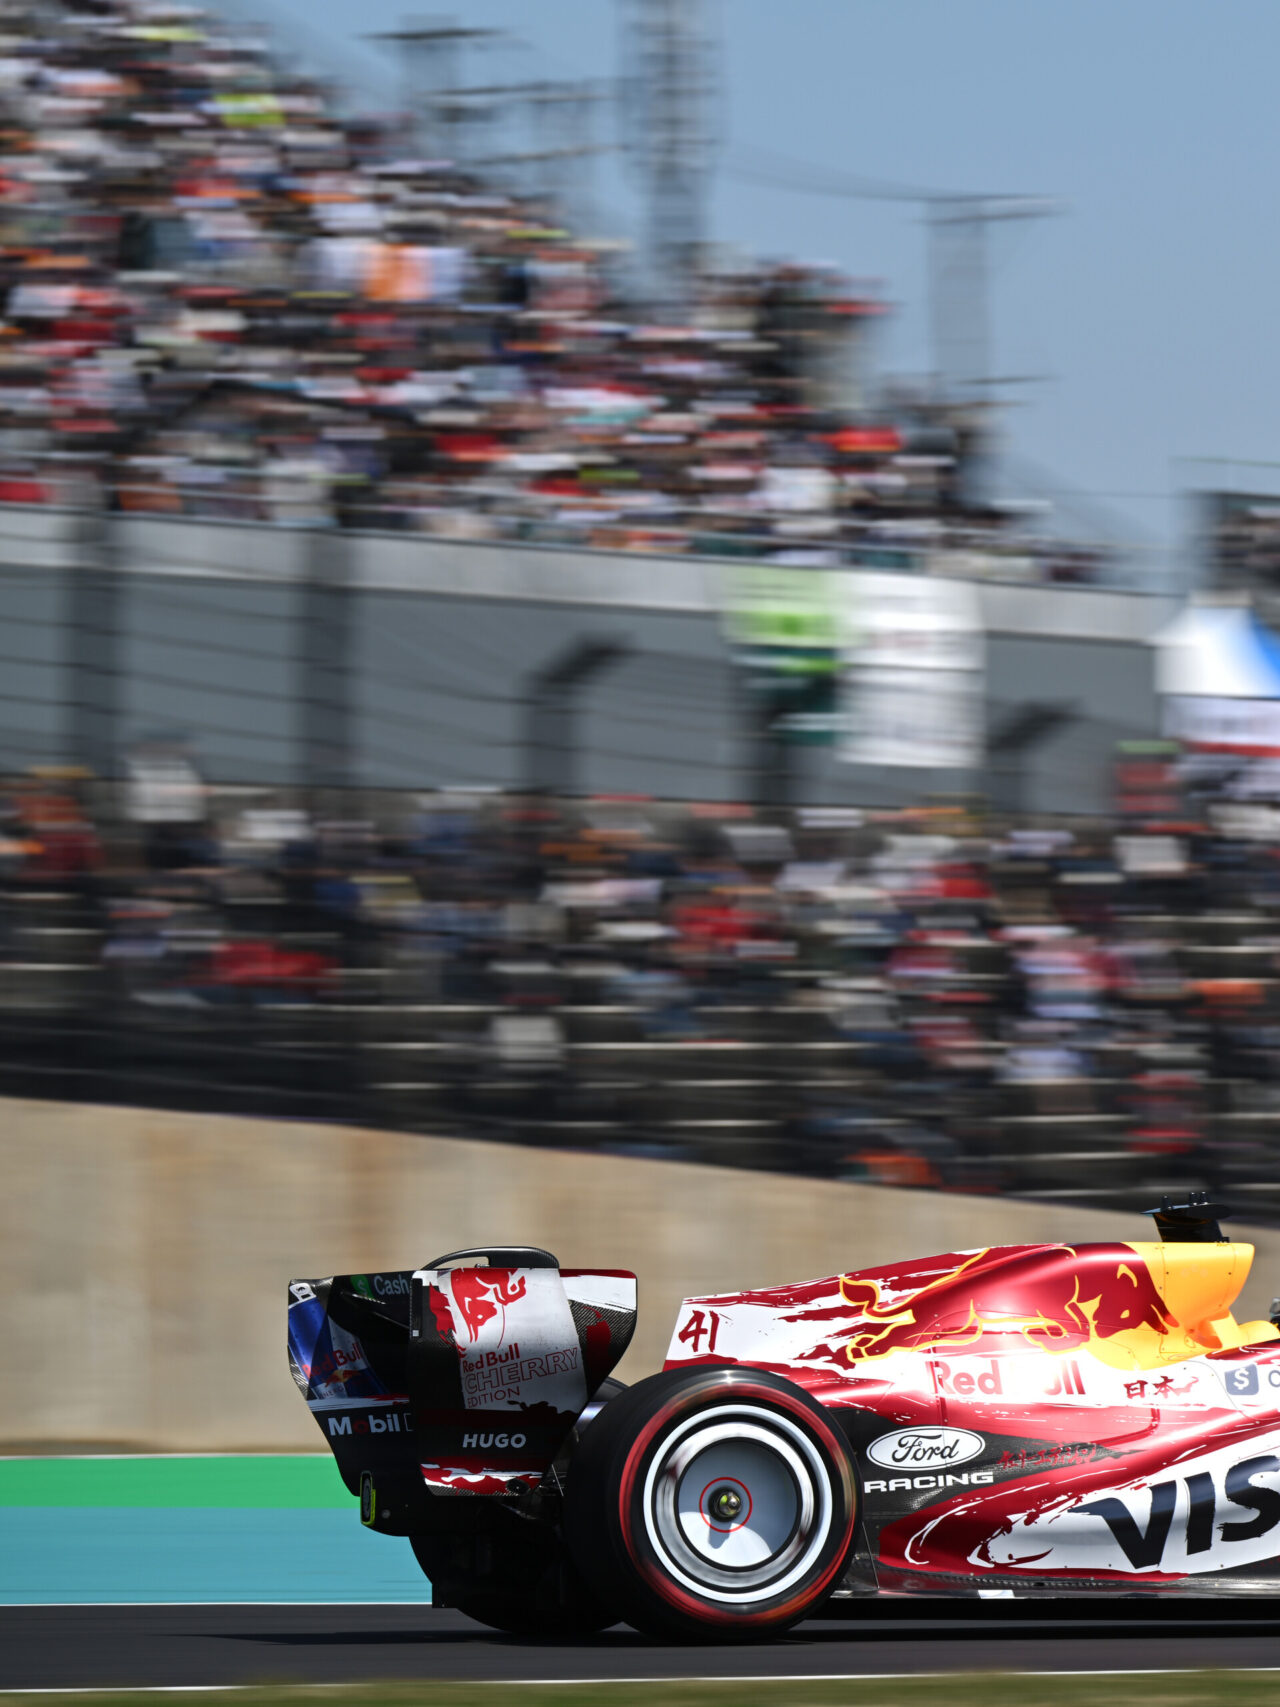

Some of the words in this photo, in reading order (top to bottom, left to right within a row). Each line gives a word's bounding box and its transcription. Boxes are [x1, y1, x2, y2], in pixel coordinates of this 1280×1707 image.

[373, 1275, 410, 1296] Cash
[678, 1310, 720, 1352] 41
[332, 1342, 363, 1367] Bull
[462, 1359, 486, 1374] Red
[486, 1343, 520, 1366] Bull
[465, 1347, 579, 1395] CHERRY
[925, 1359, 1003, 1395] Red
[467, 1386, 521, 1408] EDITION
[1123, 1375, 1180, 1400] 日本
[327, 1413, 401, 1437] Mobil
[462, 1433, 527, 1449] HUGO
[891, 1433, 960, 1464] Ford
[863, 1471, 994, 1494] RACING
